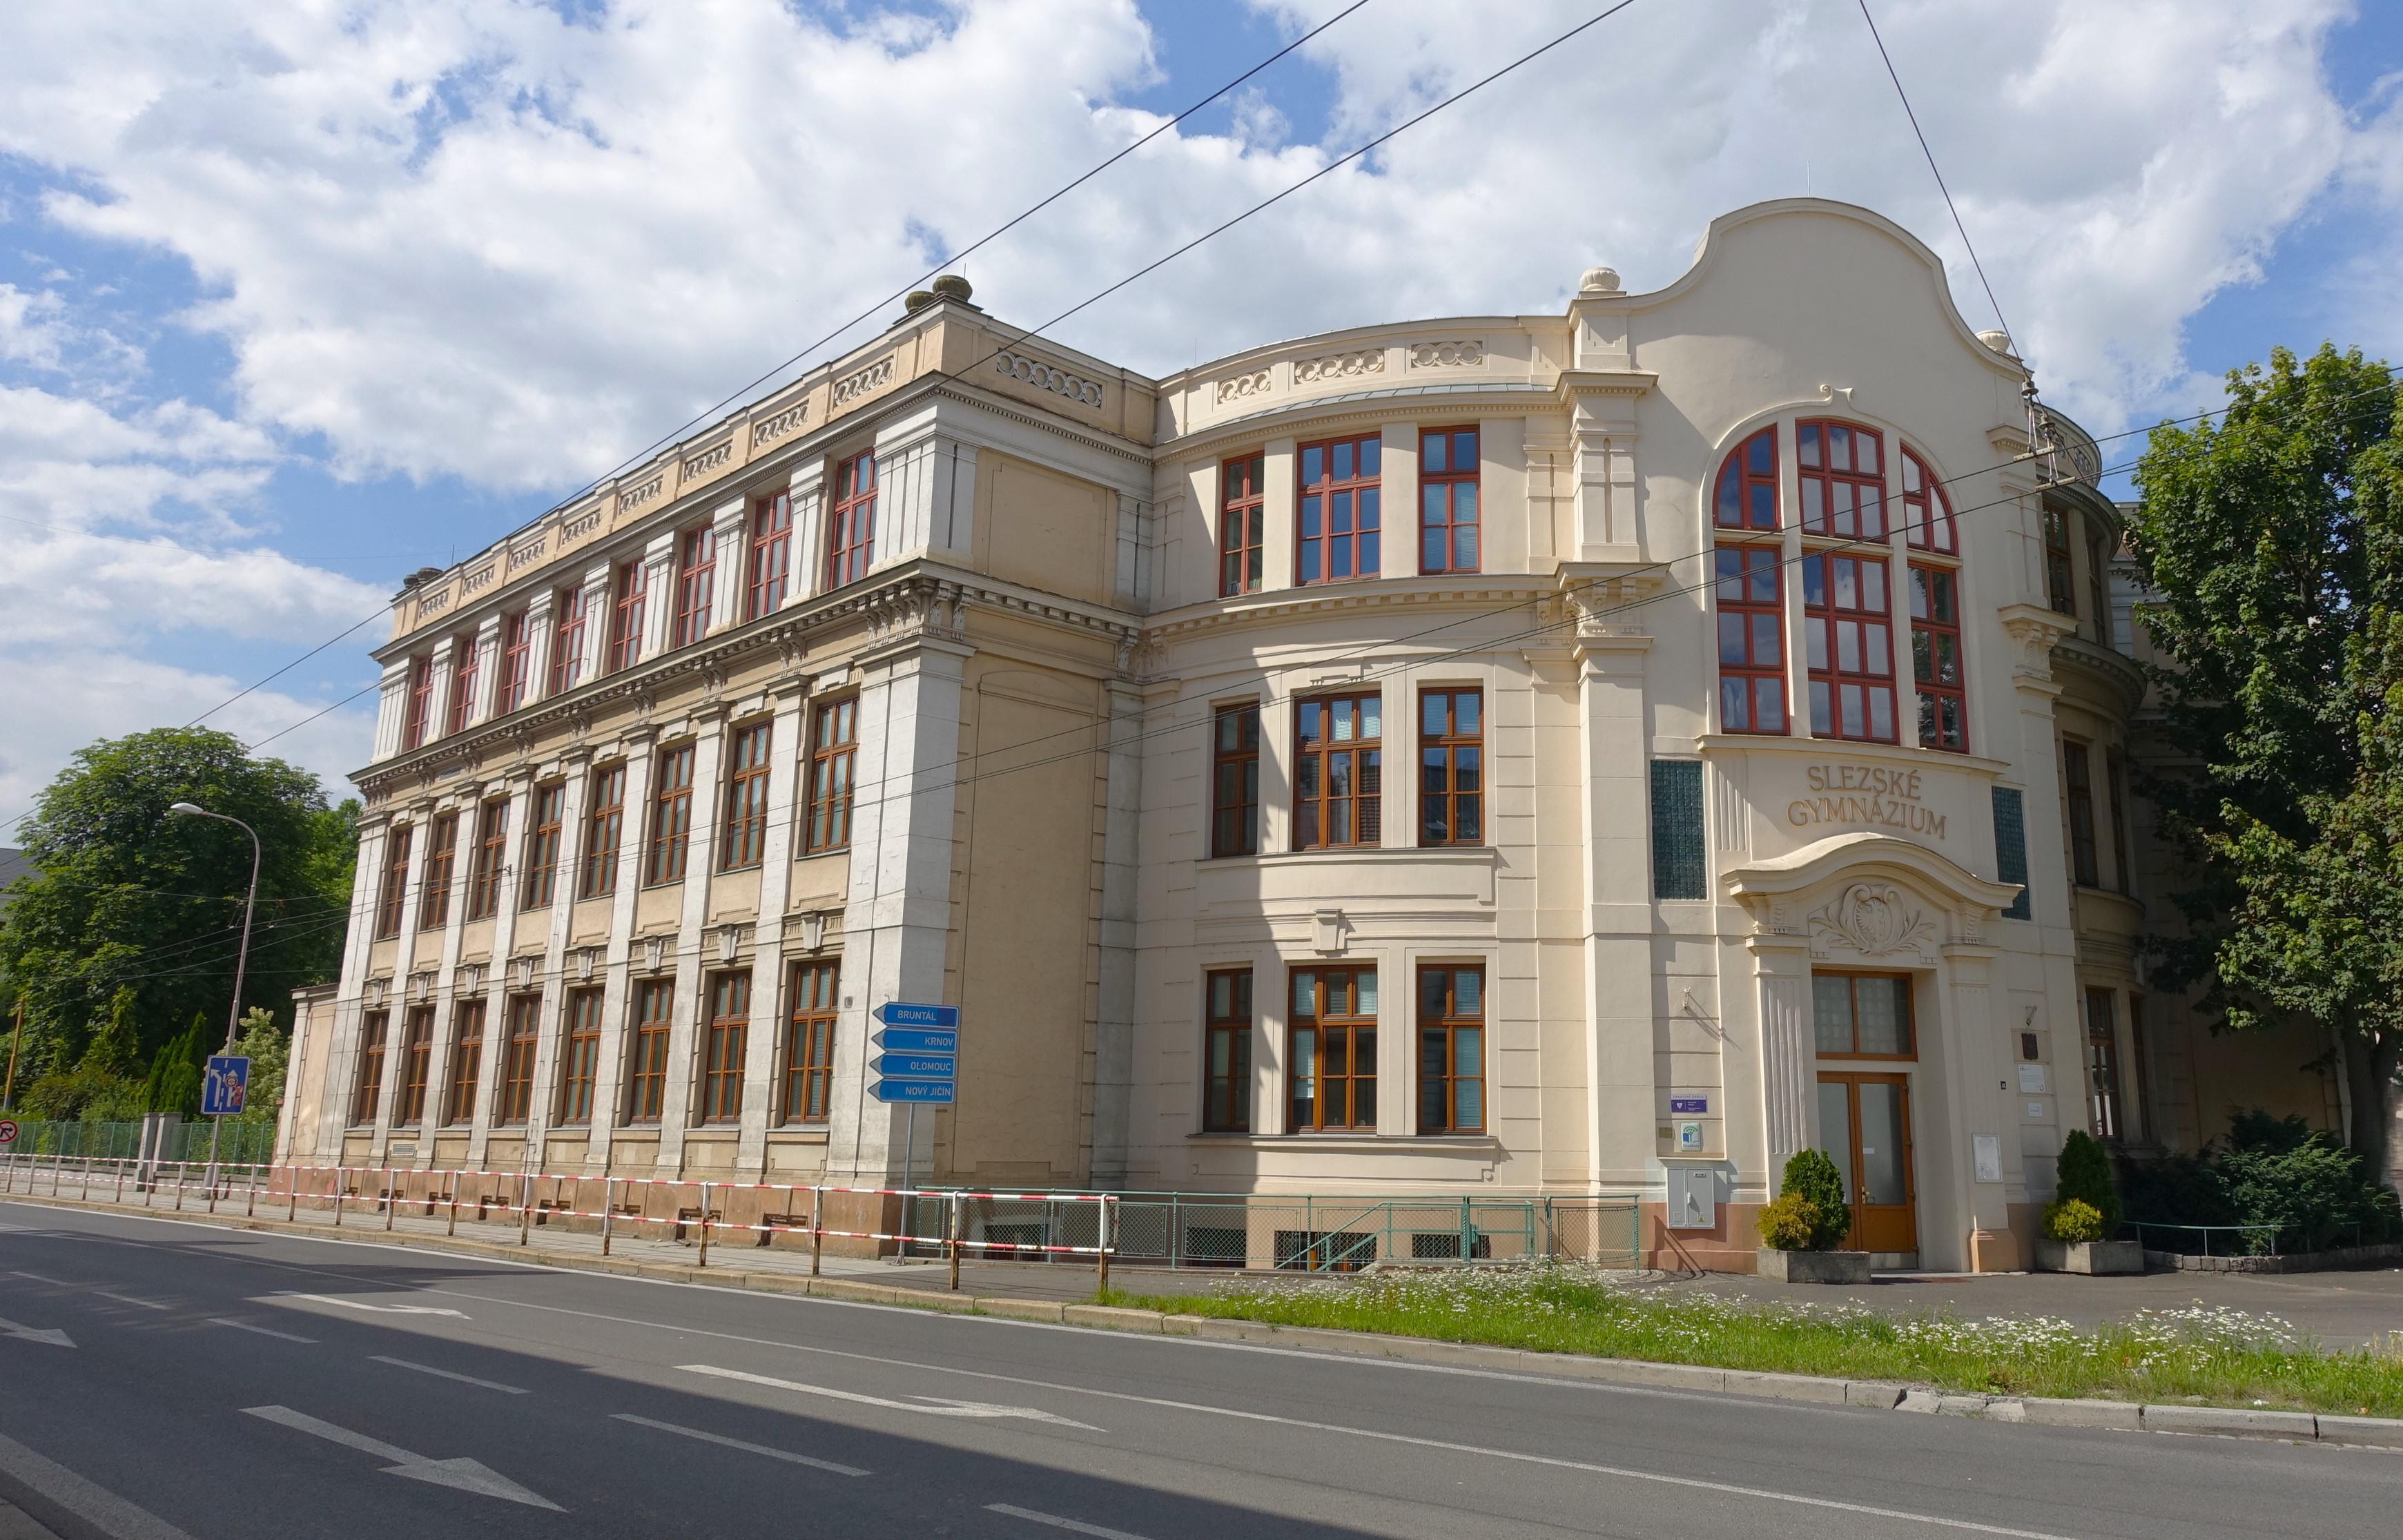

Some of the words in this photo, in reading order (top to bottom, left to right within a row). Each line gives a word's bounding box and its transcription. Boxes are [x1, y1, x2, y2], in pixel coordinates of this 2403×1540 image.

[1807, 766, 1922, 801] SLEZSKÉ
[1786, 794, 1947, 840] GYMNÁZIUM
[897, 1010, 937, 1021] BRUNTÁL
[924, 1037, 953, 1046] KRNOV
[911, 1061, 951, 1071] OLOMOUC
[905, 1085, 928, 1095] NOVÝ
[930, 1086, 951, 1096] JIČÍN
